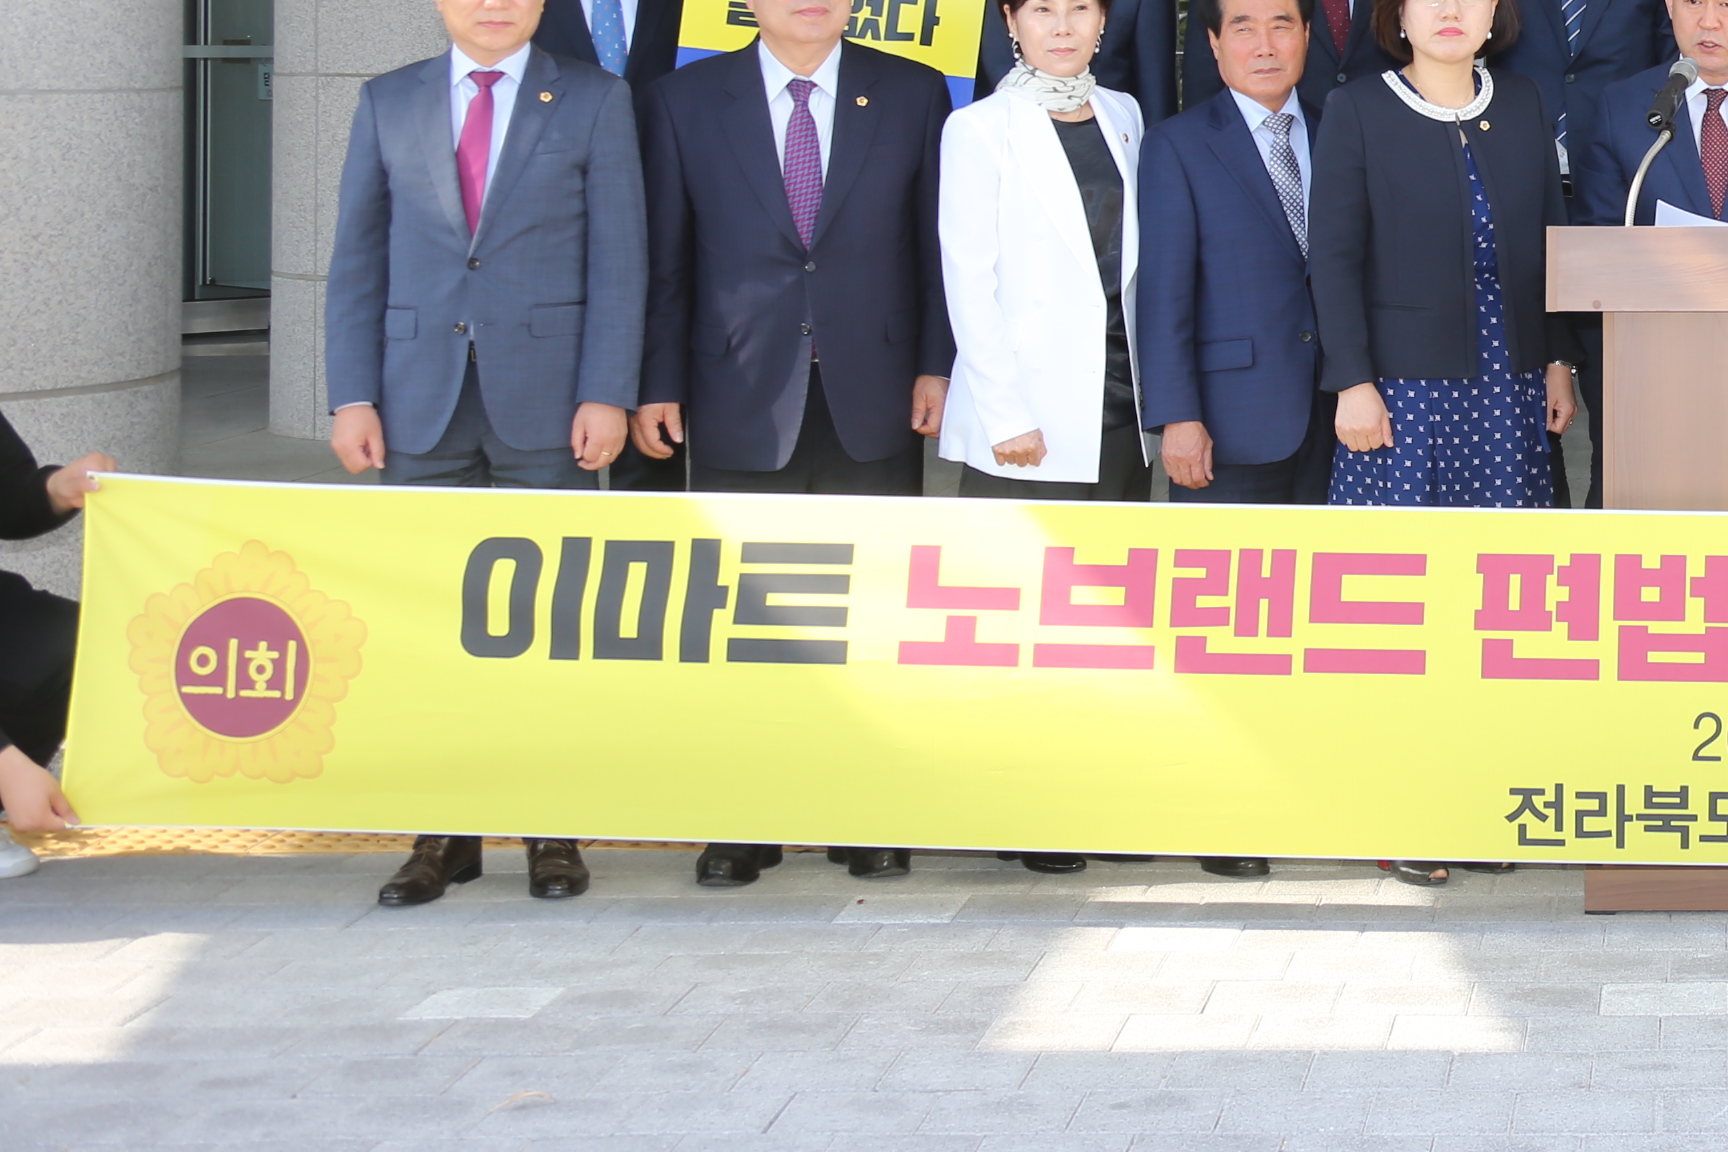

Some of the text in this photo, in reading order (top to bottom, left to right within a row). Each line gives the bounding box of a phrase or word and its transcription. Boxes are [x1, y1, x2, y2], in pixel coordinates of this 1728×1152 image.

[460, 536, 855, 665] 이마트
[897, 545, 1428, 676] 노브랜드
[180, 637, 297, 701] 의회
